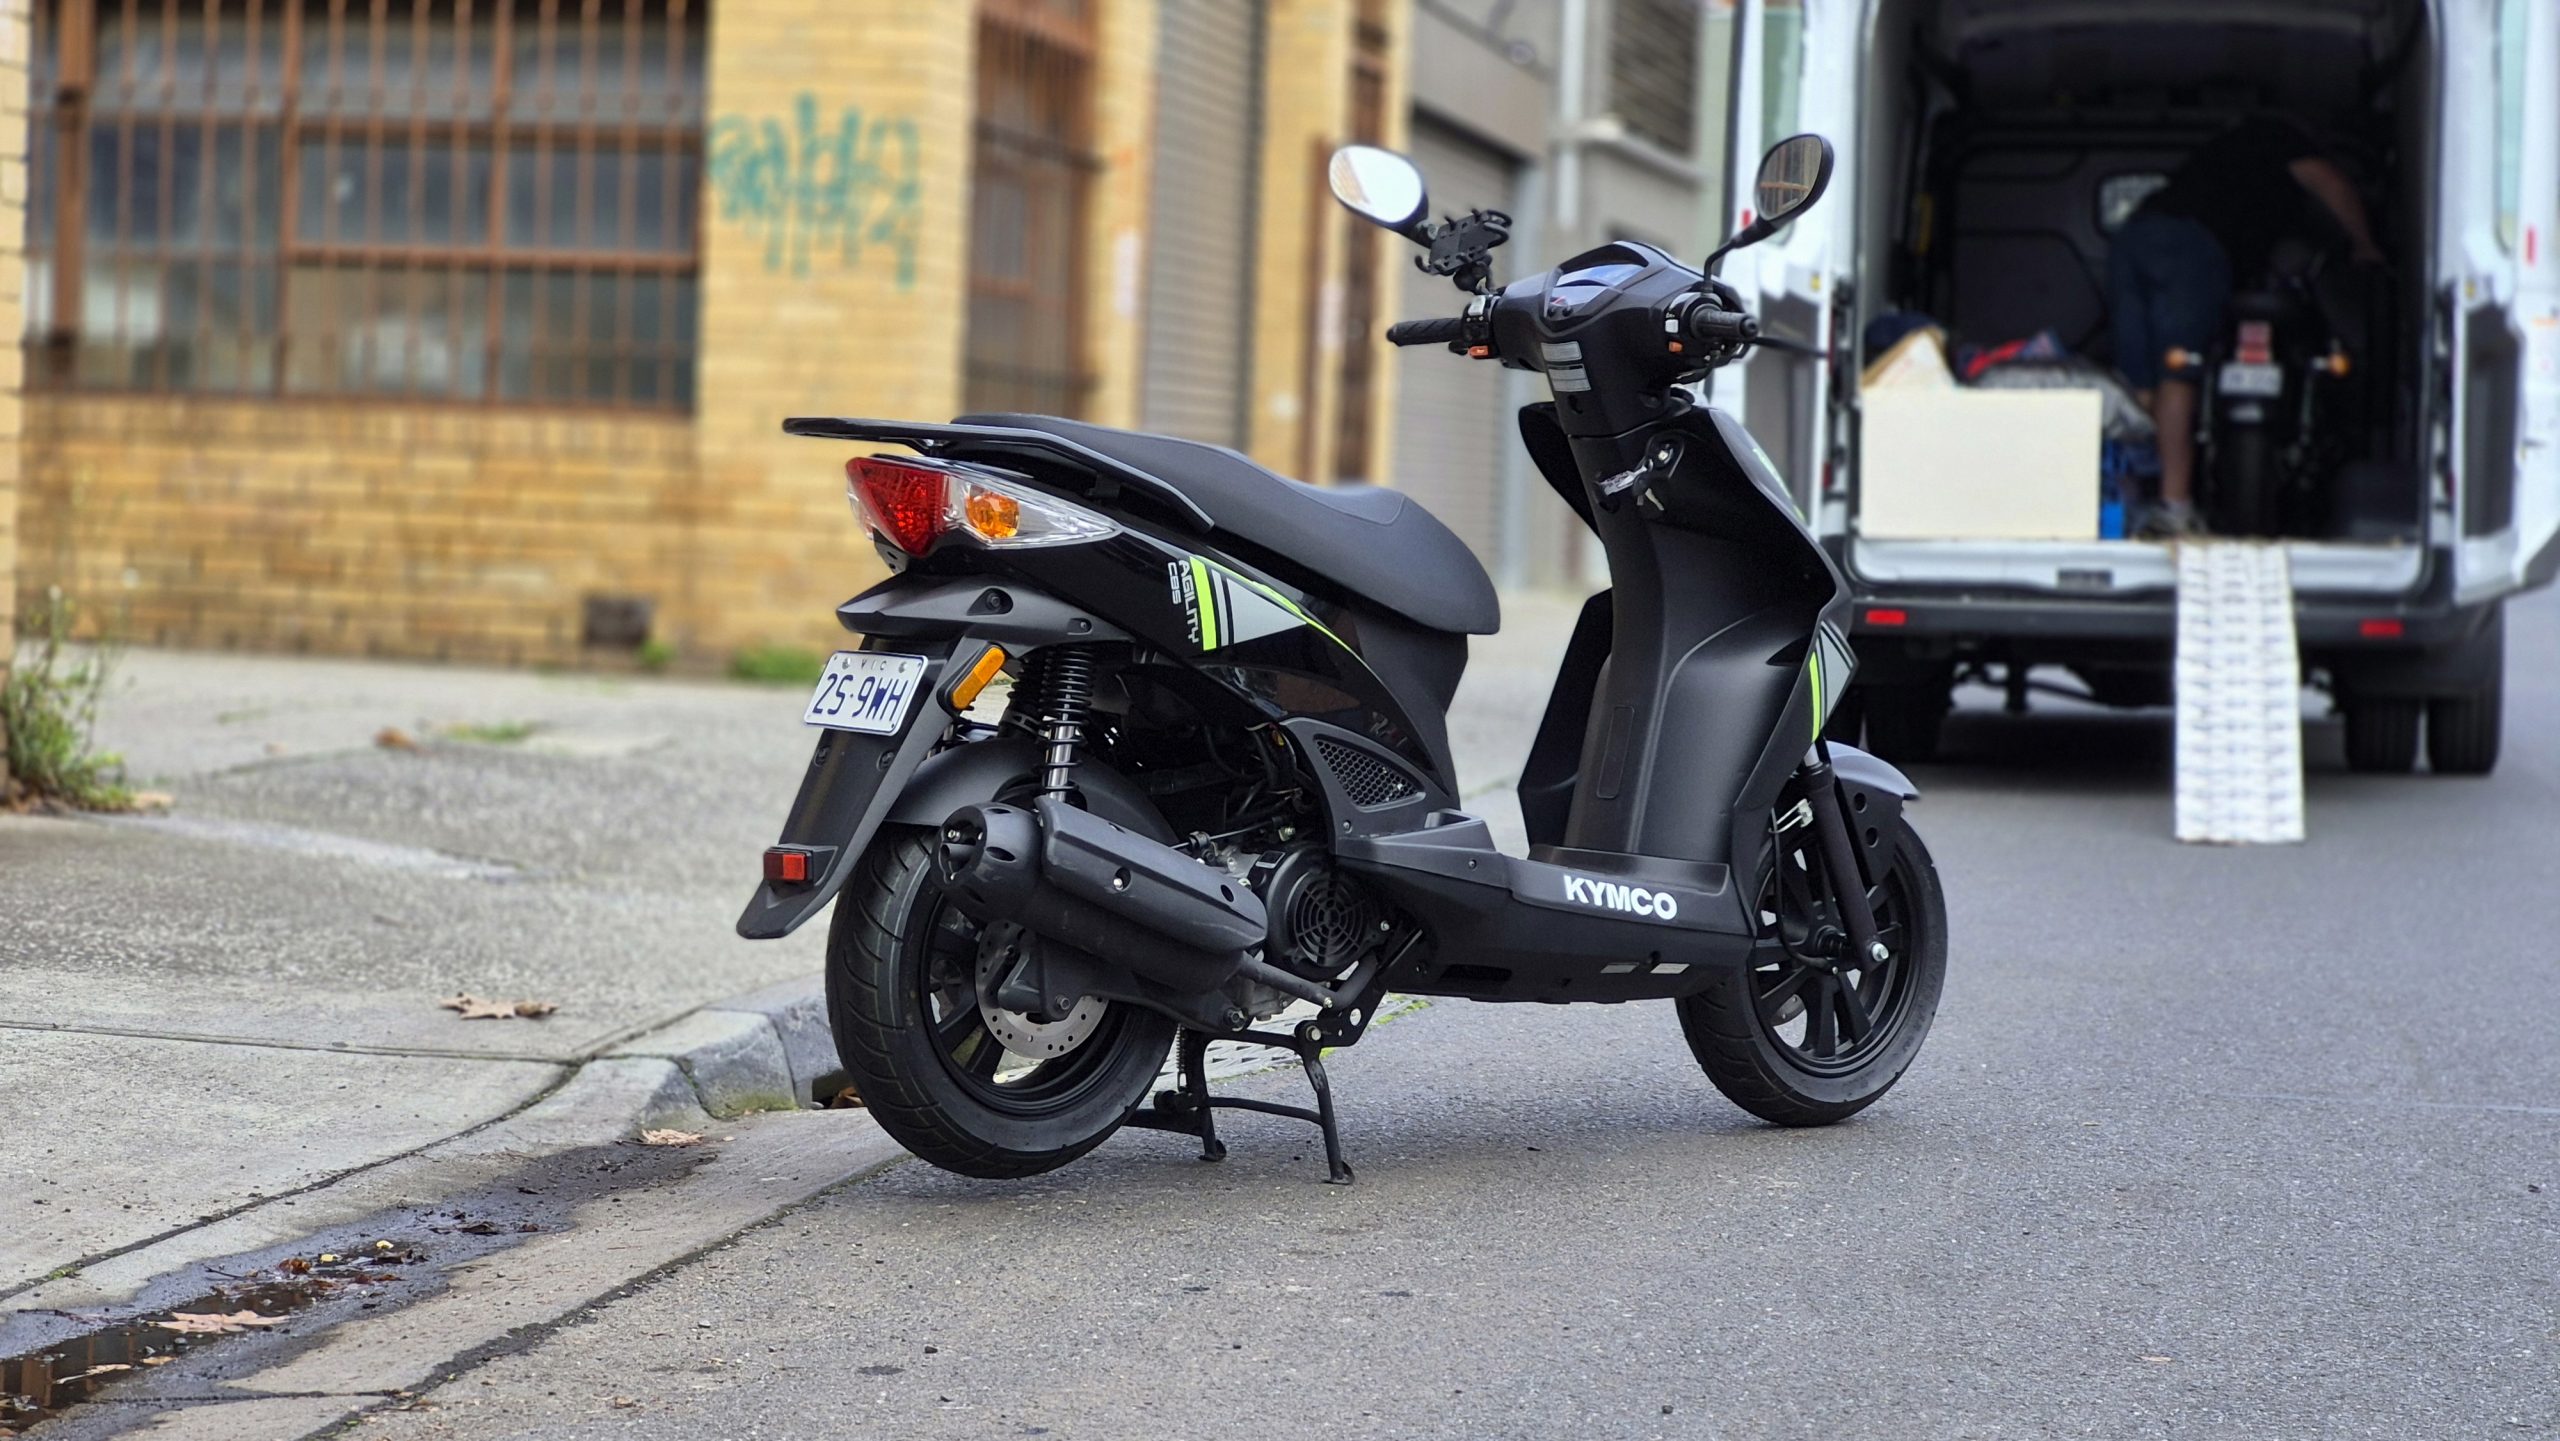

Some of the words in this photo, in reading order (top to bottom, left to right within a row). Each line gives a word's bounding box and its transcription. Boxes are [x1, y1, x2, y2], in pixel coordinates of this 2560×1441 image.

[1167, 562, 1182, 605] CBS
[1178, 560, 1200, 644] AGILITY
[861, 660, 887, 671] VIC
[1563, 874, 1678, 920] KYMCO
